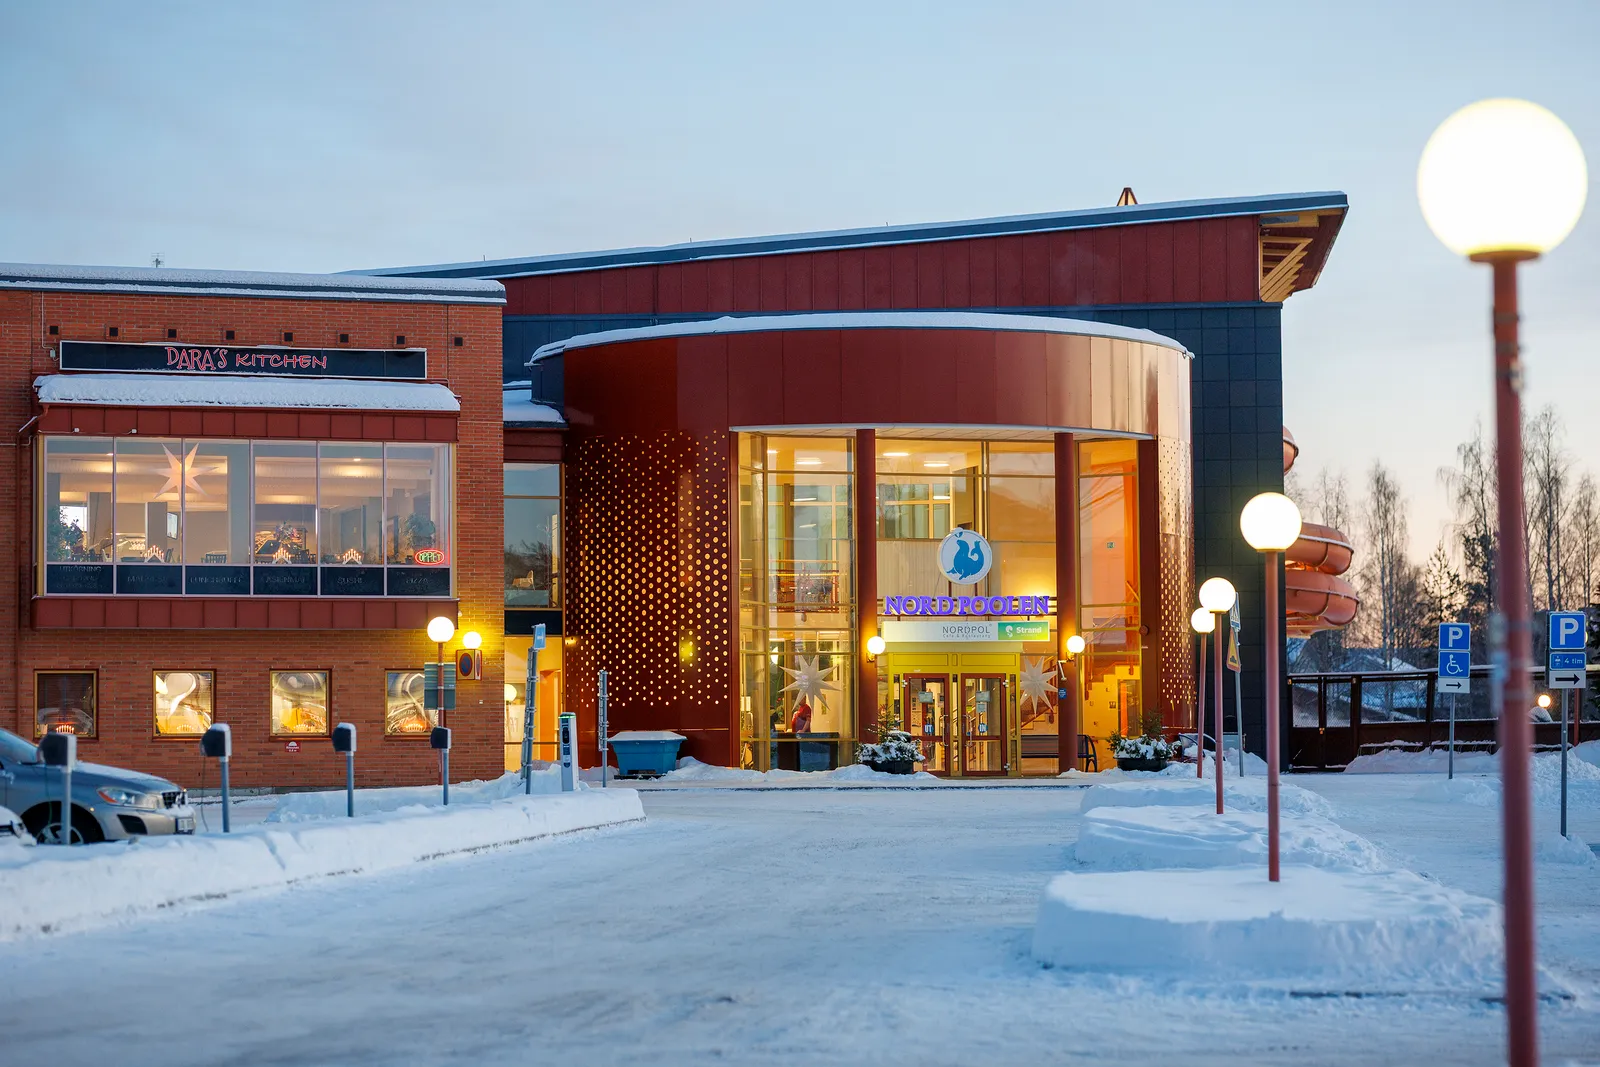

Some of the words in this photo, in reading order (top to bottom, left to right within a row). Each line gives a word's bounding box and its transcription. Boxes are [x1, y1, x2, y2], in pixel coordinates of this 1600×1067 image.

[236, 353, 327, 369] KITCHEN
[942, 626, 990, 634] NORDPOL
[1016, 626, 1042, 634] Strand
[1449, 627, 1463, 647] P
[1560, 617, 1579, 646] P
